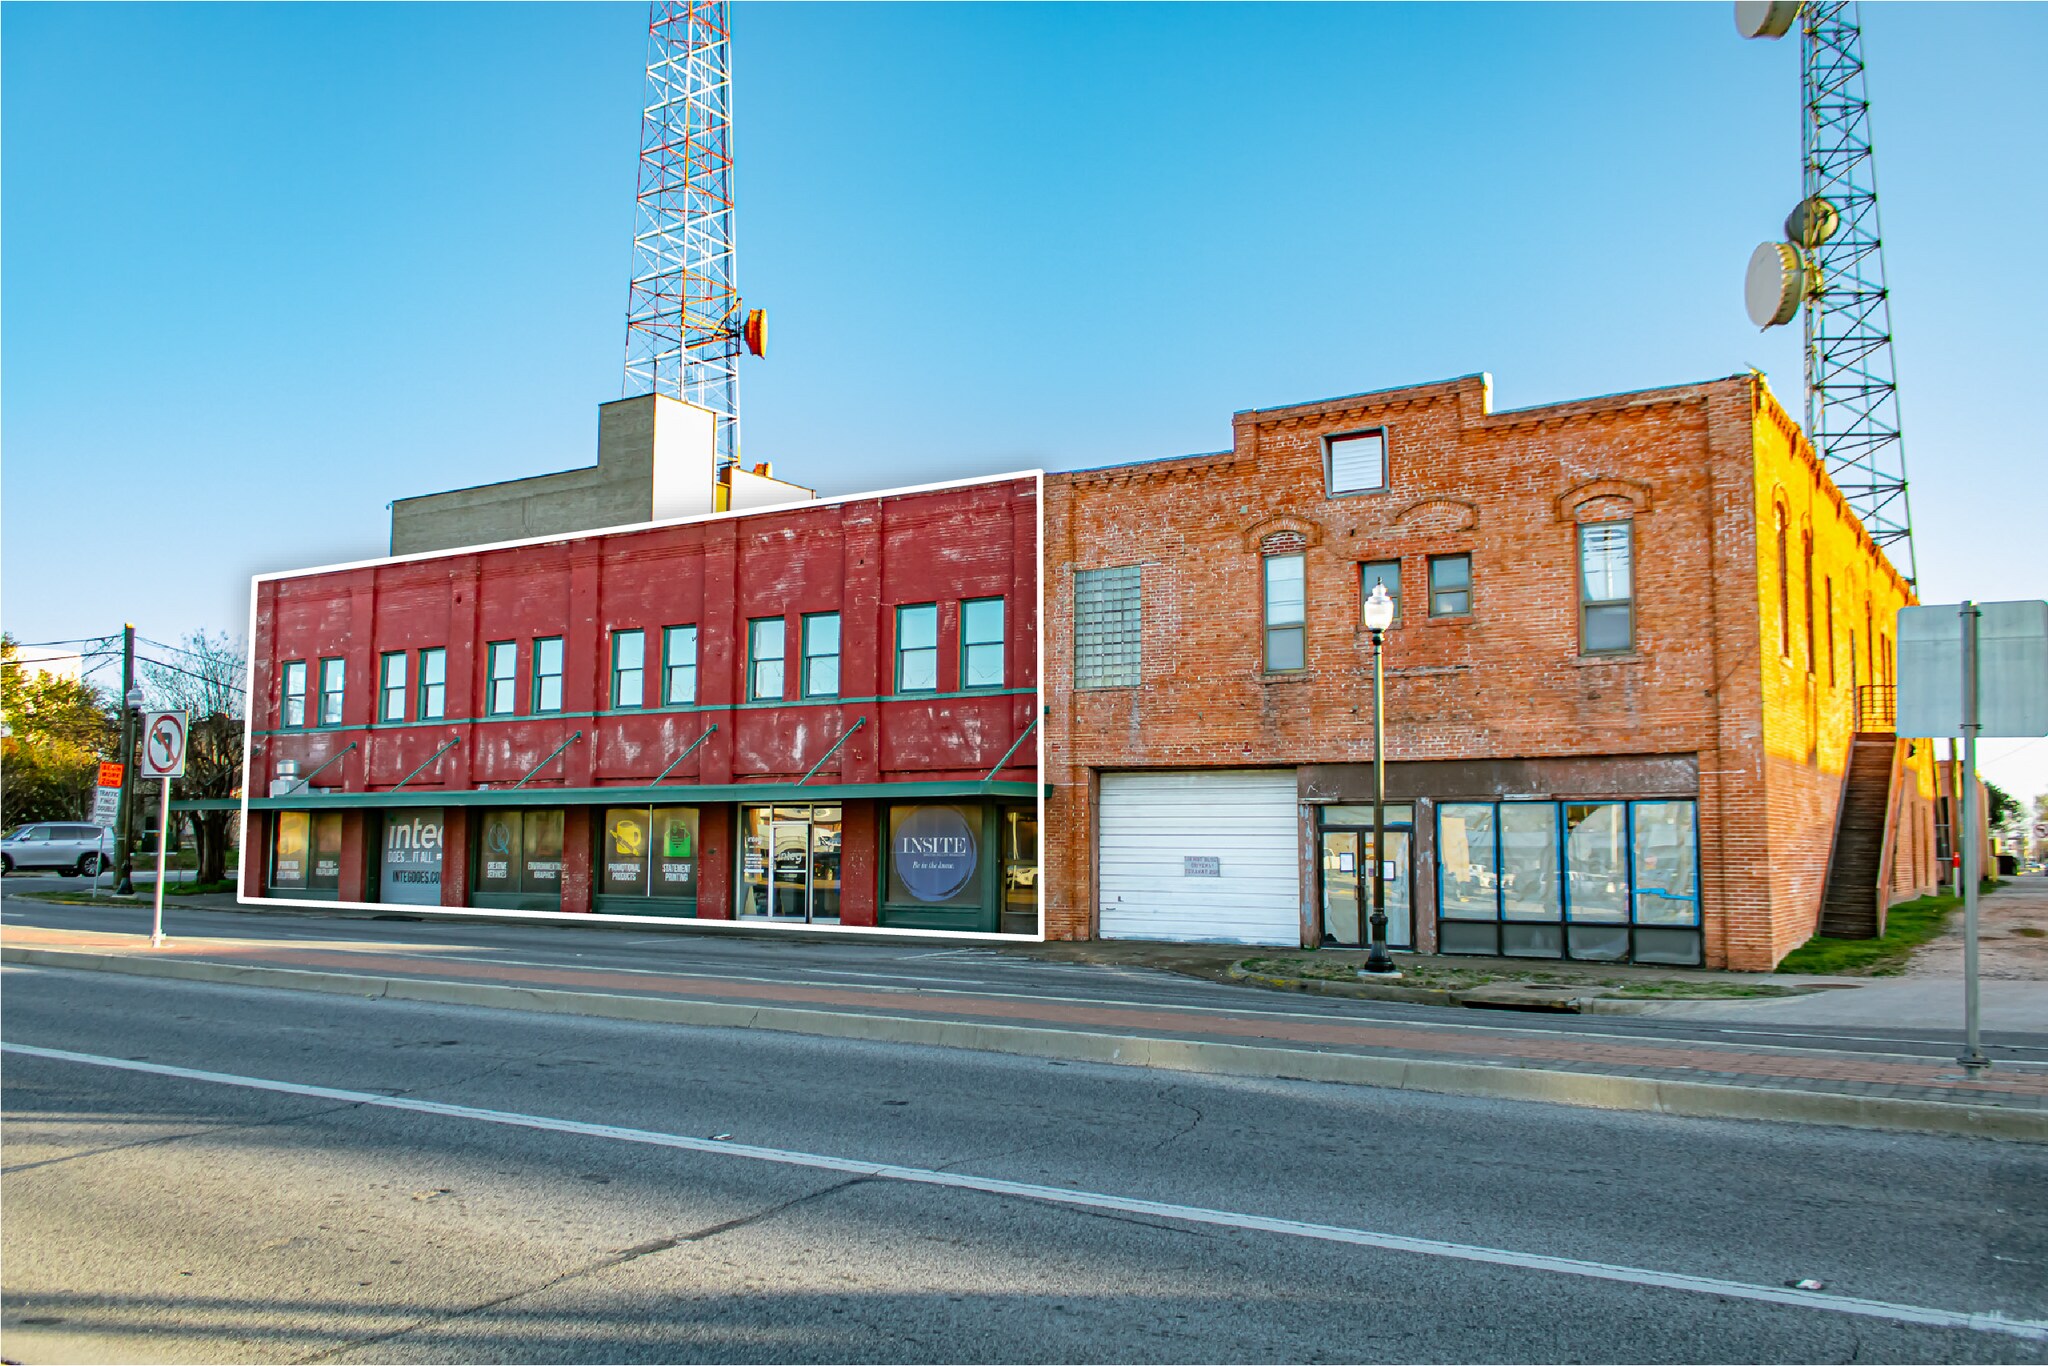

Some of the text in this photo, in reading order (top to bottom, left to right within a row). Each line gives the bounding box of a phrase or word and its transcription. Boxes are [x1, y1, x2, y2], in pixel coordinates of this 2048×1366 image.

[388, 818, 444, 849] inte
[903, 837, 967, 854] INSITE
[608, 863, 641, 873] PROMOTIONAL
[662, 863, 691, 873] STATEMENT
[612, 872, 637, 881] PRODUCTS
[664, 872, 689, 882] PRINTING
